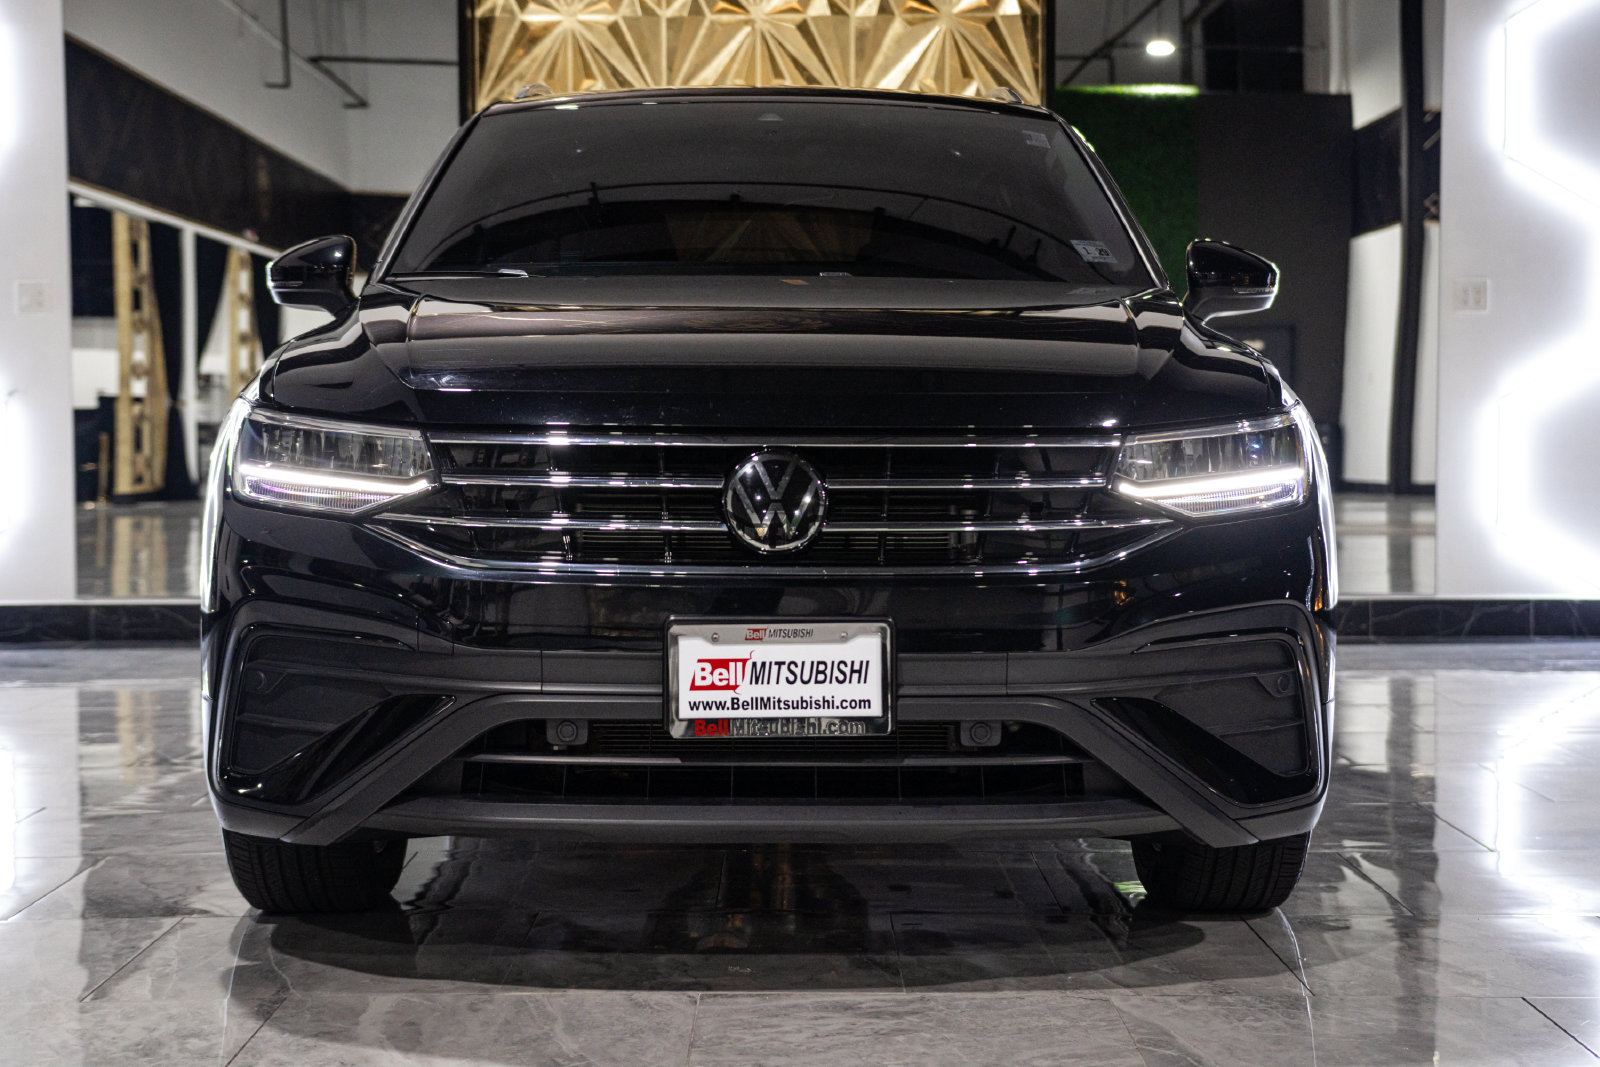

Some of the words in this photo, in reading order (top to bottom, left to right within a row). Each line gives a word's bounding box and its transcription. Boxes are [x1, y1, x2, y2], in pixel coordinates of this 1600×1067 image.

[746, 629, 766, 640] Bell
[768, 628, 814, 639] MITSUBISHI
[693, 661, 743, 686] Bell
[749, 660, 870, 685] MITSUBISHI
[688, 696, 871, 711] www.BellMitsubishi.com
